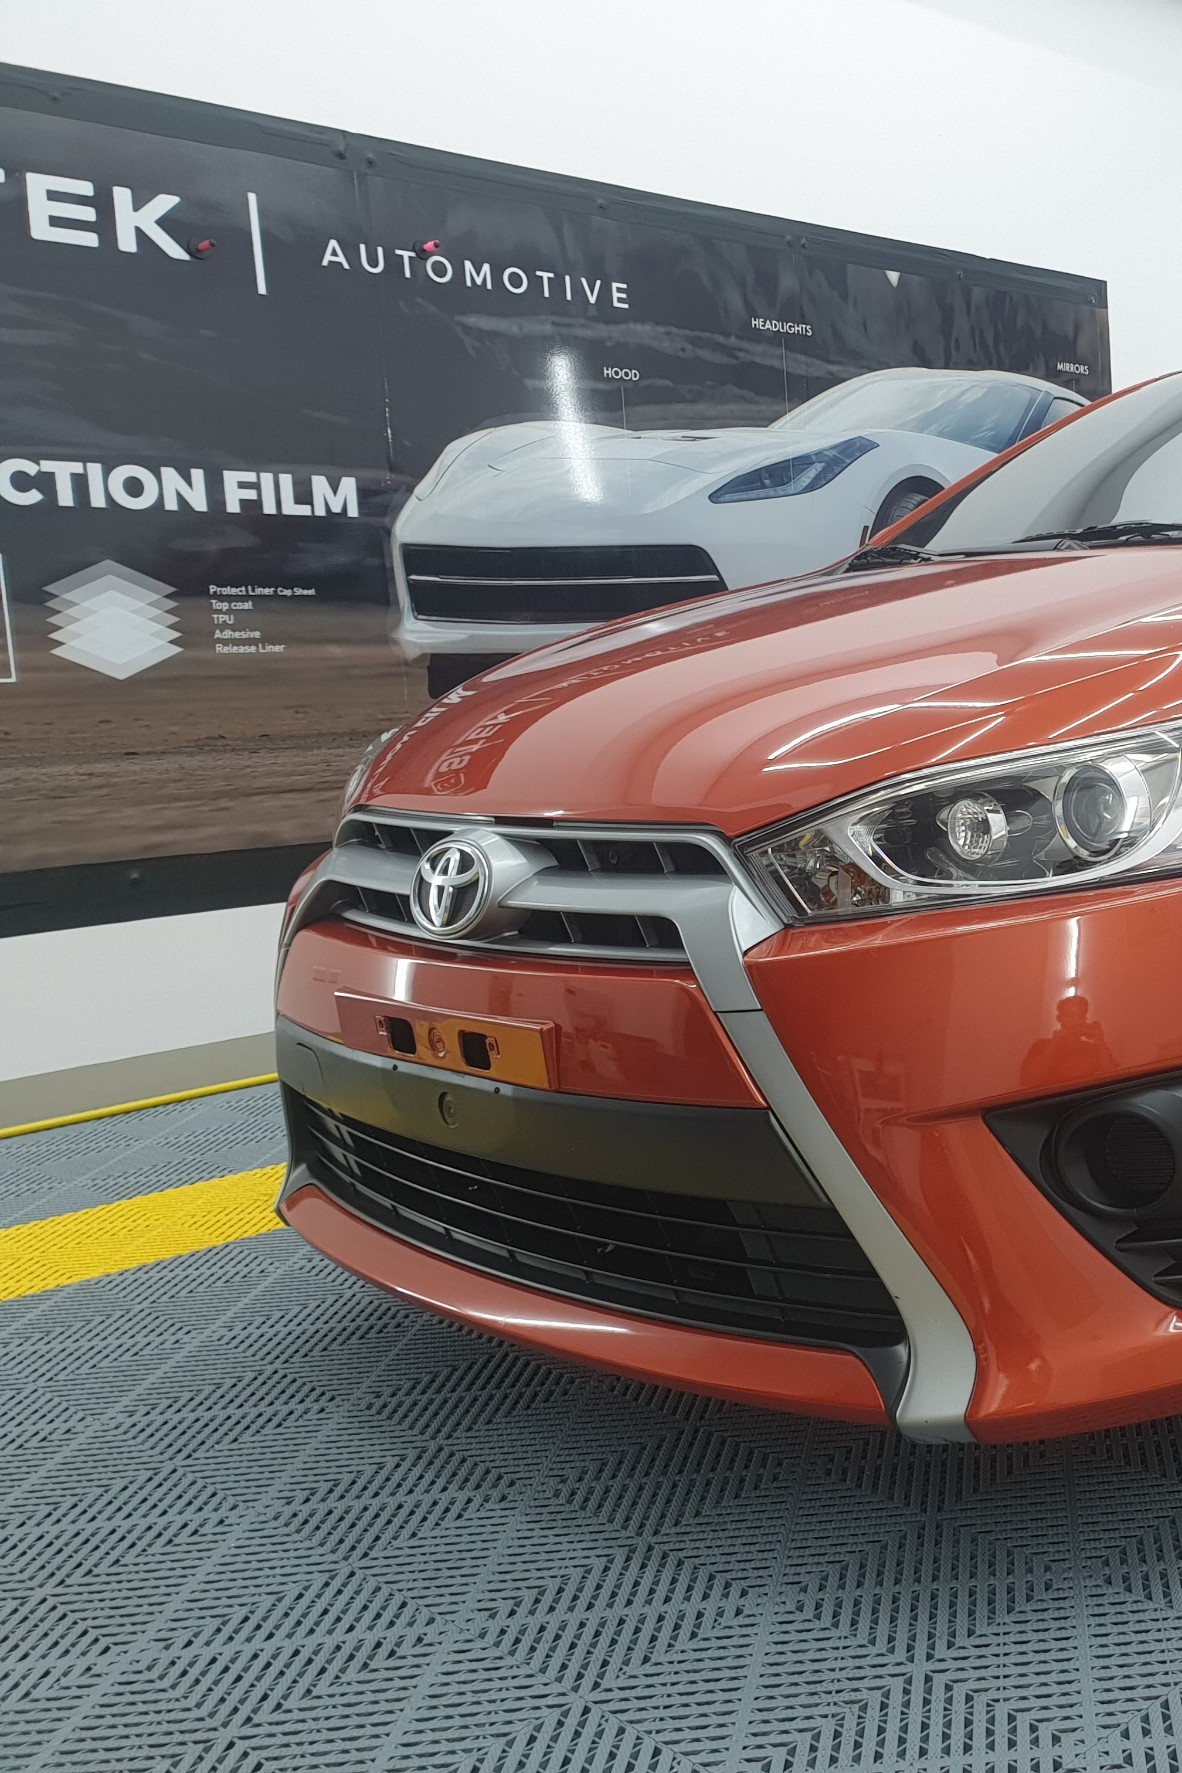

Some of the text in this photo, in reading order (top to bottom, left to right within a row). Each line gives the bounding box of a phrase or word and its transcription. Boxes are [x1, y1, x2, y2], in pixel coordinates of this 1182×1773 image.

[0, 168, 191, 261] EK
[321, 238, 629, 309] AUTOMOTIVE
[751, 317, 813, 336] HEADLIGHTS
[603, 366, 640, 381] HOOD
[1056, 361, 1089, 375] MIRRORS
[0, 458, 360, 517] CTION FILM
[209, 585, 316, 597] Protect Liner Cap Sheet
[210, 600, 254, 612] Top coat
[212, 614, 235, 624] TPU
[214, 629, 261, 639] Adhesive
[215, 643, 286, 654] Release Liner
